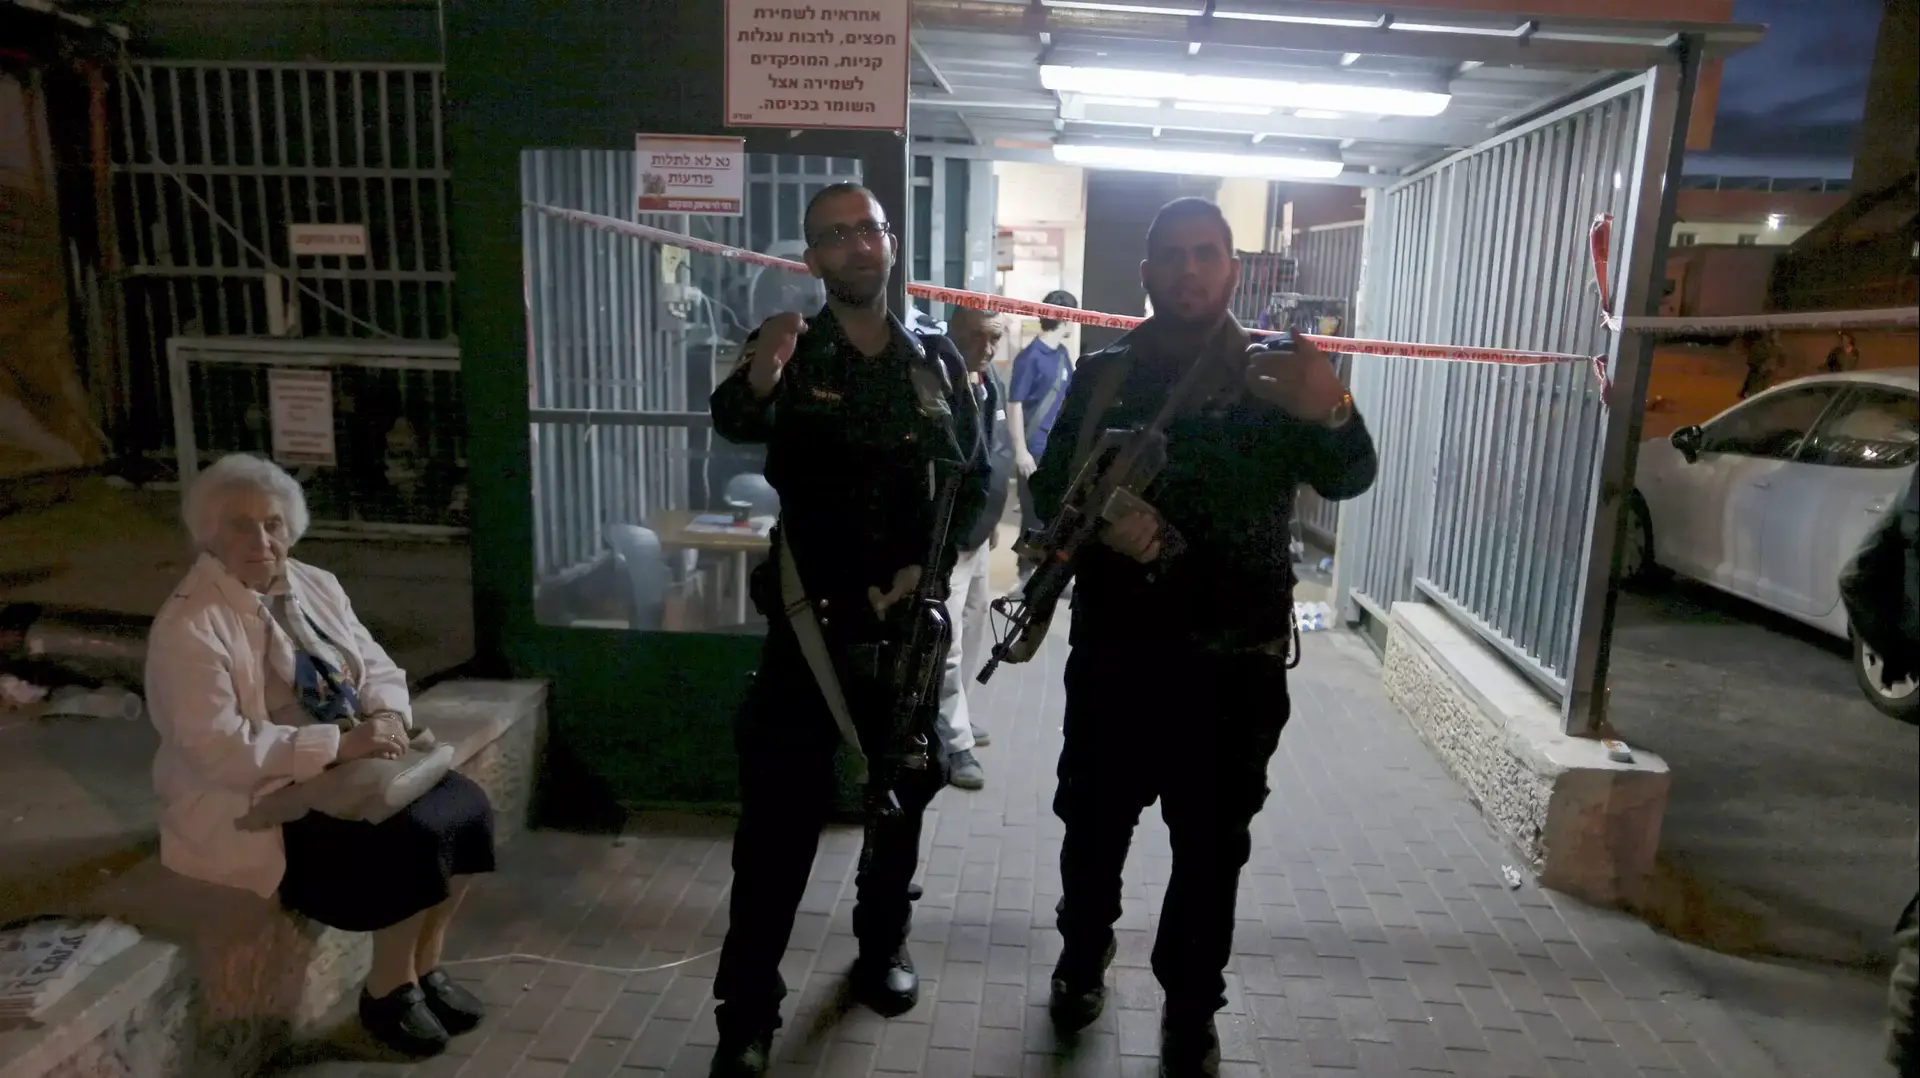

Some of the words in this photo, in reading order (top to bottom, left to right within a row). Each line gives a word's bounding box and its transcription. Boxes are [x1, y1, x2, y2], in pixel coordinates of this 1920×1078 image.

[753, 6, 816, 20] לשמירת
[820, 8, 881, 22] אחראית
[737, 27, 784, 43] עגלות
[788, 29, 834, 44] לרבות
[840, 33, 896, 46] חפצים,
[750, 53, 829, 69] המופקדים
[834, 56, 883, 71] קניות,
[768, 73, 799, 89] אצל
[803, 76, 864, 91] לשמירה
[758, 98, 819, 112] בכניסה.
[825, 100, 876, 113] השומר
[651, 153, 691, 166] לתלות
[694, 153, 712, 167] לא
[715, 157, 731, 167] נא
[667, 173, 714, 185] מודעות
